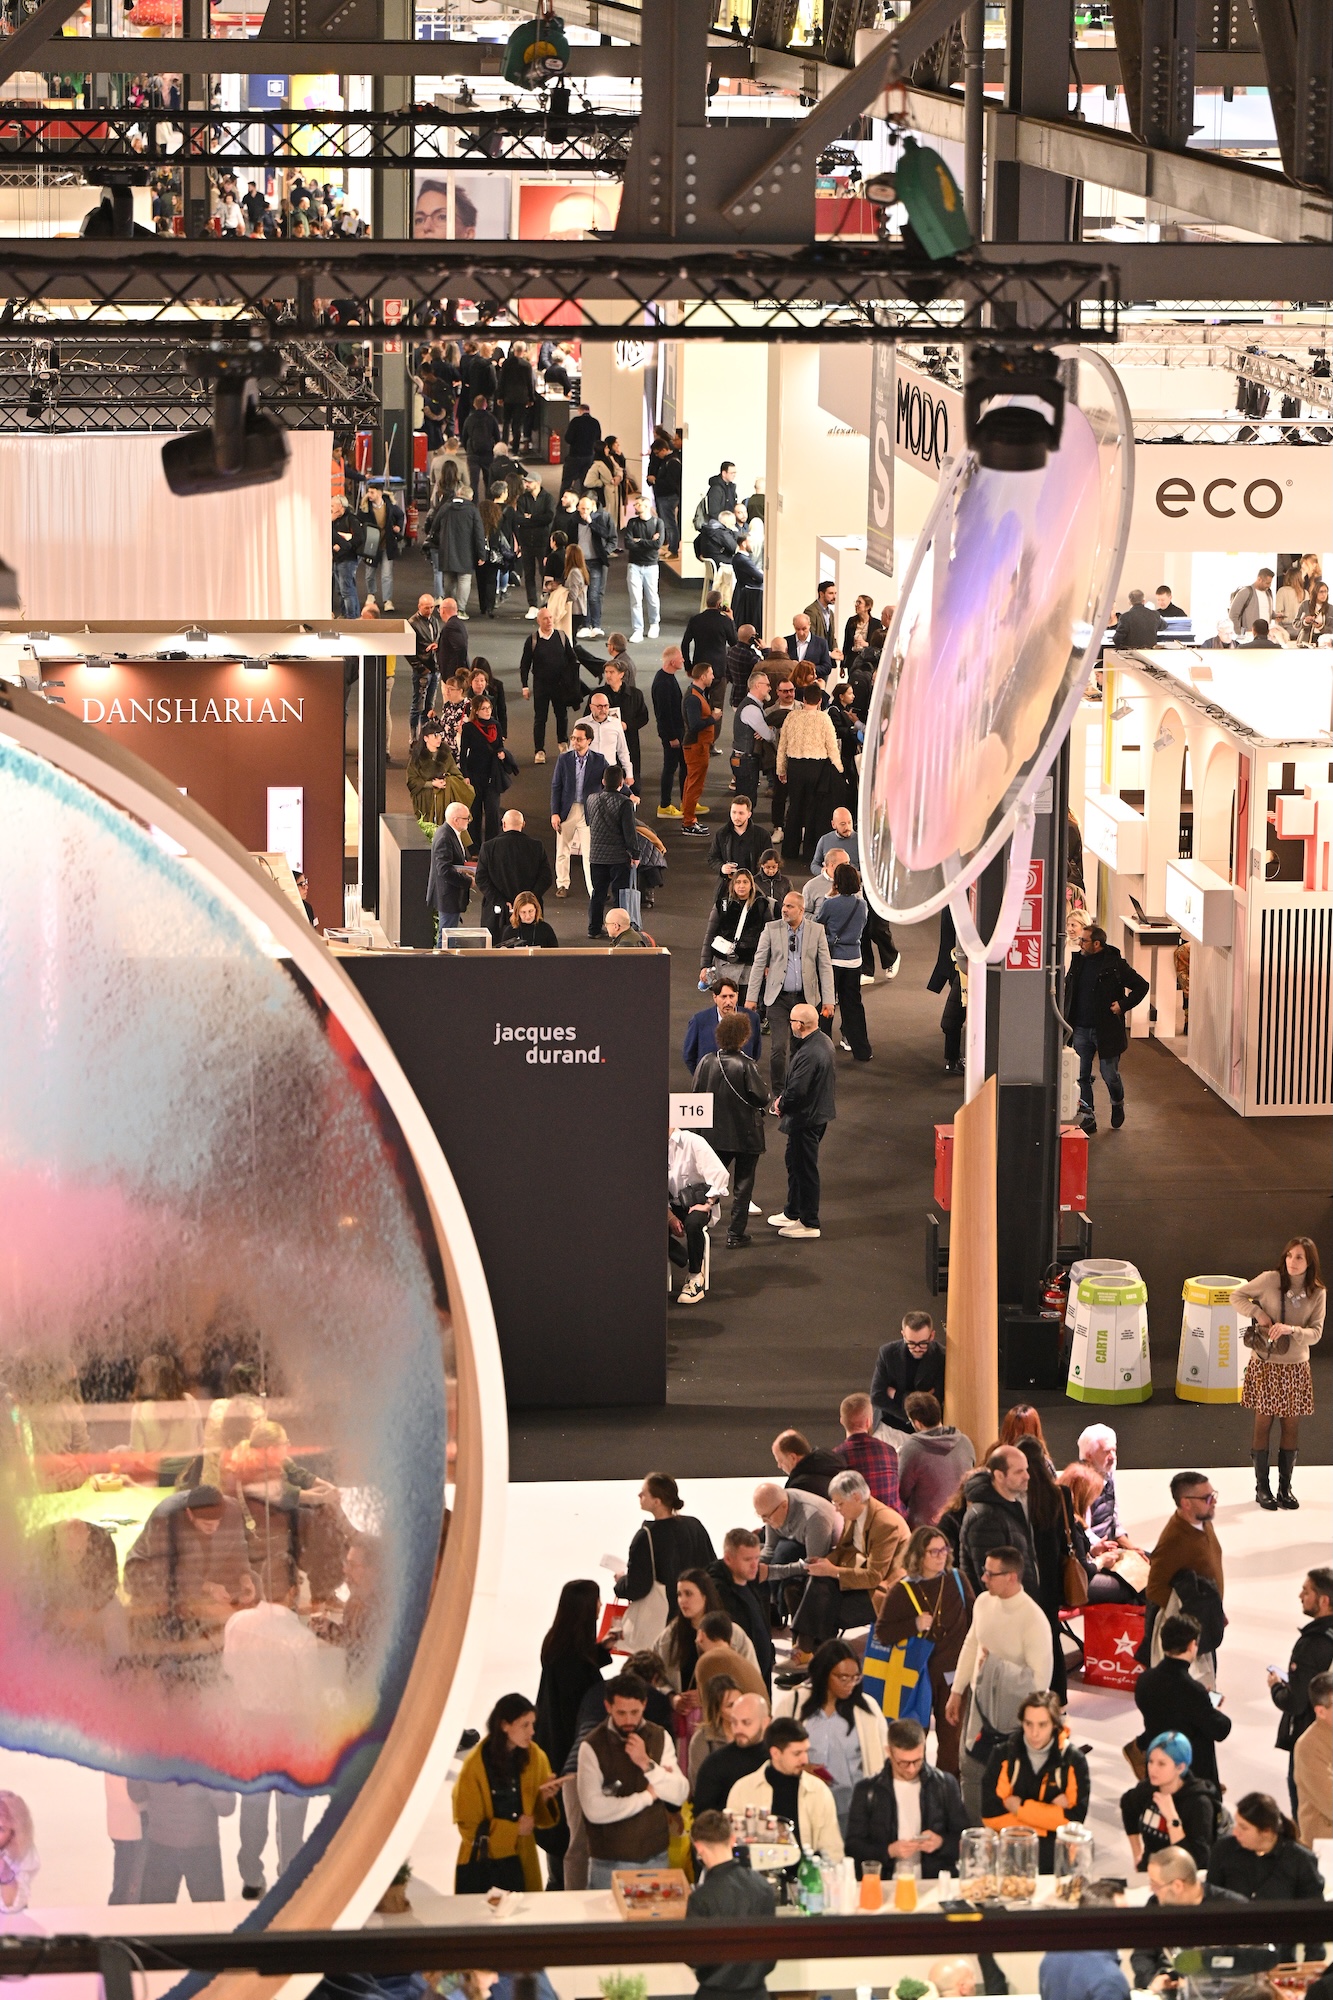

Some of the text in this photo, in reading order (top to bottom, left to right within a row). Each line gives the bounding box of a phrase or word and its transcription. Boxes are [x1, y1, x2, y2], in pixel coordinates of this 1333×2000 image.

[896, 377, 949, 470] MODO
[873, 420, 890, 528] S
[1155, 477, 1283, 519] eco
[81, 697, 305, 724] DANSHARIAN
[493, 1023, 577, 1045] jacques
[525, 1045, 606, 1064] durand.
[679, 1105, 704, 1117] T16
[1095, 1330, 1108, 1364] CARTA
[1218, 1325, 1231, 1368] PLASTIC
[1086, 1655, 1145, 1675] POLA
